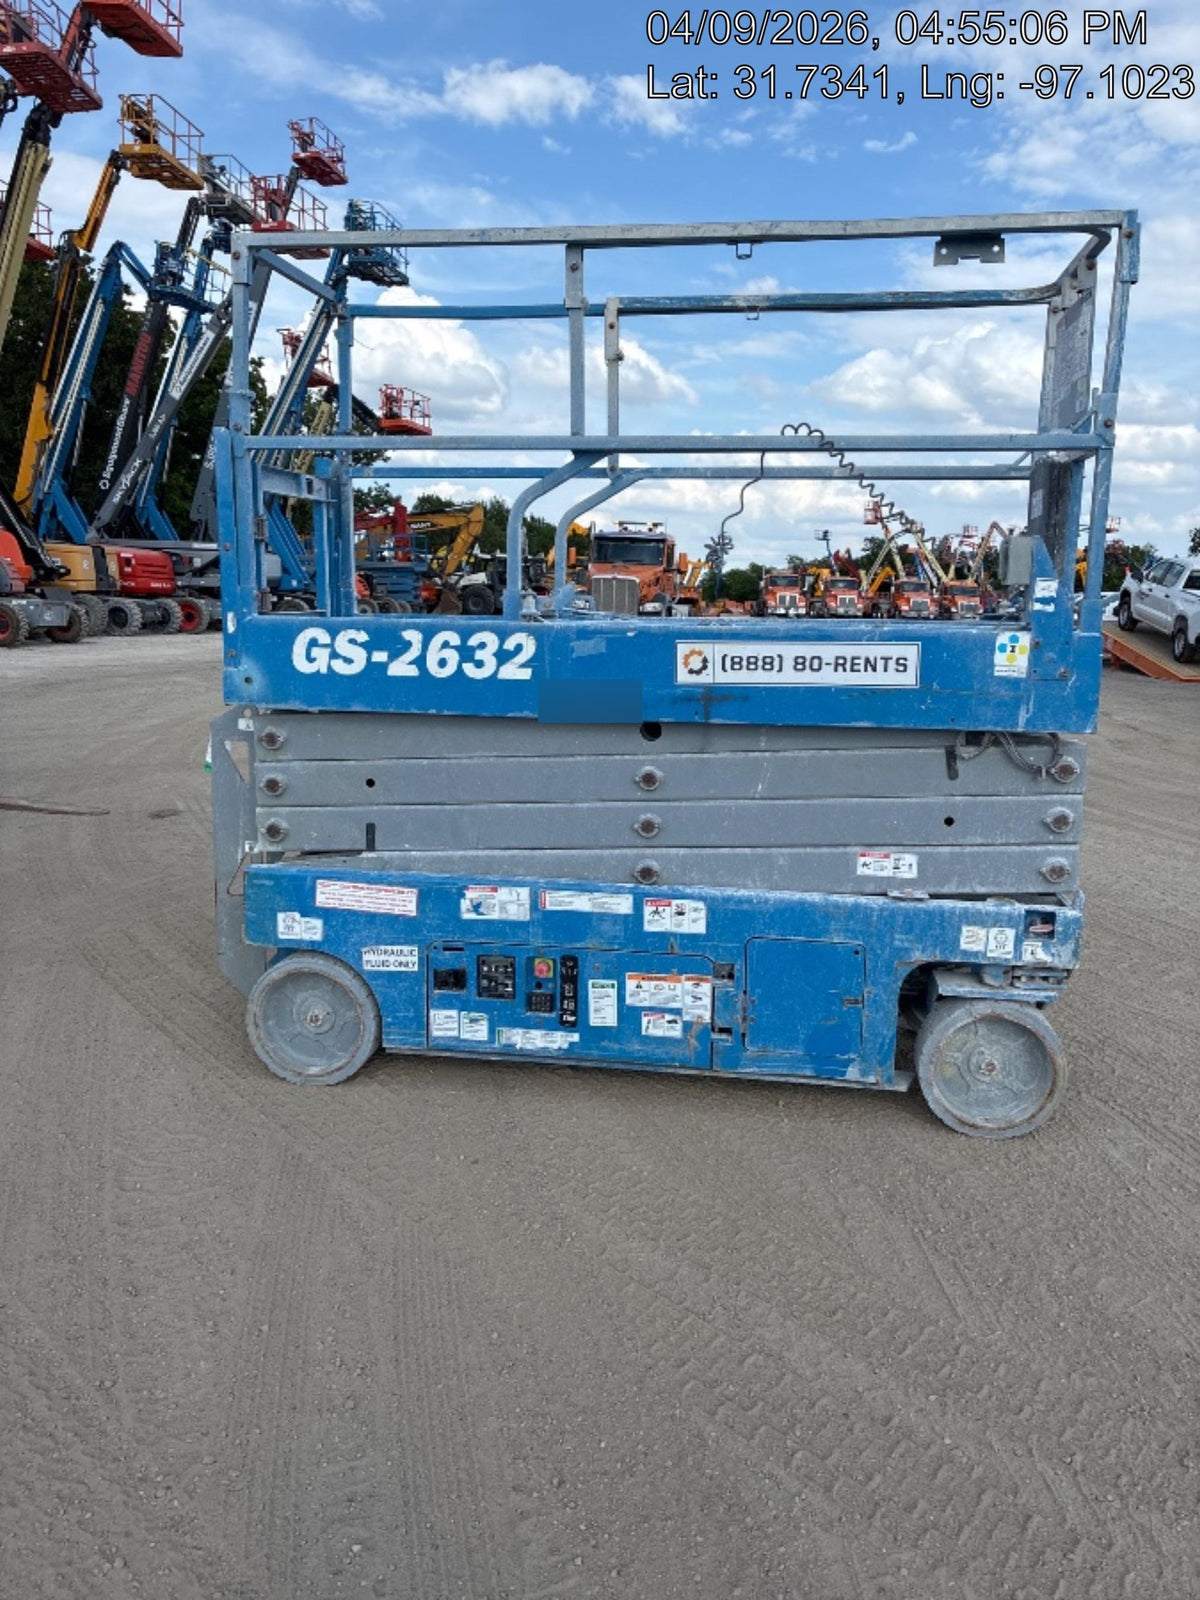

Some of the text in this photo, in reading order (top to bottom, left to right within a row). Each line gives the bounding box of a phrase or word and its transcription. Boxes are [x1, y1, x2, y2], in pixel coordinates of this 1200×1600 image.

[124, 331, 151, 396] MANITOU
[102, 395, 130, 478] EquipmentShare
[112, 457, 142, 504] SKYJACK
[291, 627, 537, 680] GS-2632
[721, 654, 908, 673] (888) 80-RENTS
[363, 947, 417, 957] HYDRAULIC
[365, 959, 417, 969] FLUID ONLY
